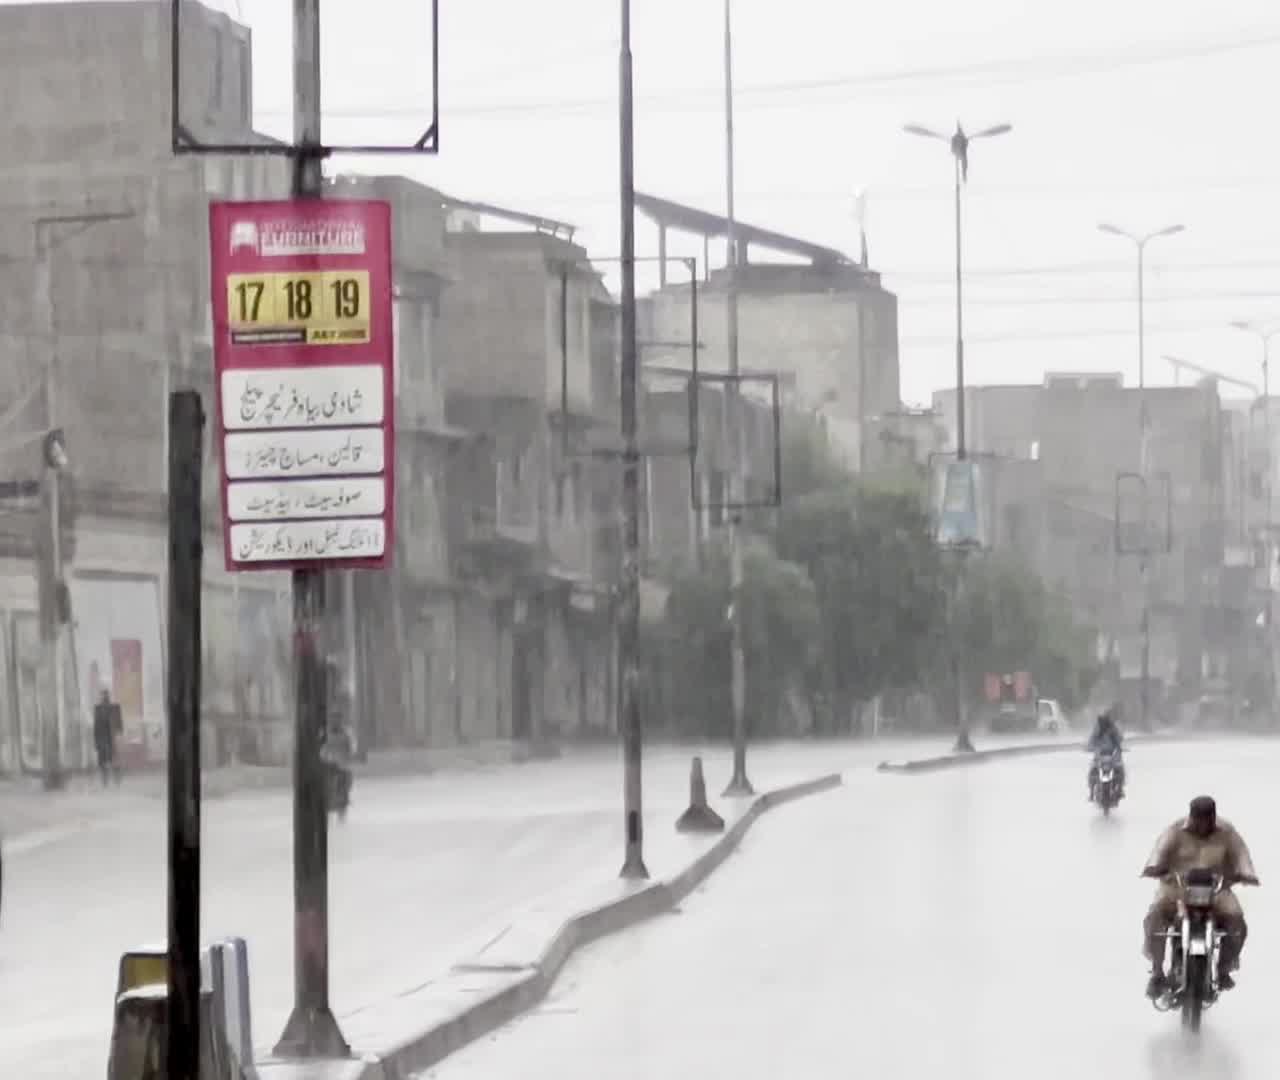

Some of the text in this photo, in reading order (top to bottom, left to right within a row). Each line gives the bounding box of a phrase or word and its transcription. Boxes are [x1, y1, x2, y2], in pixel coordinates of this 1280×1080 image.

[235, 278, 359, 321] 17 18 19
[321, 389, 362, 418] شادی
